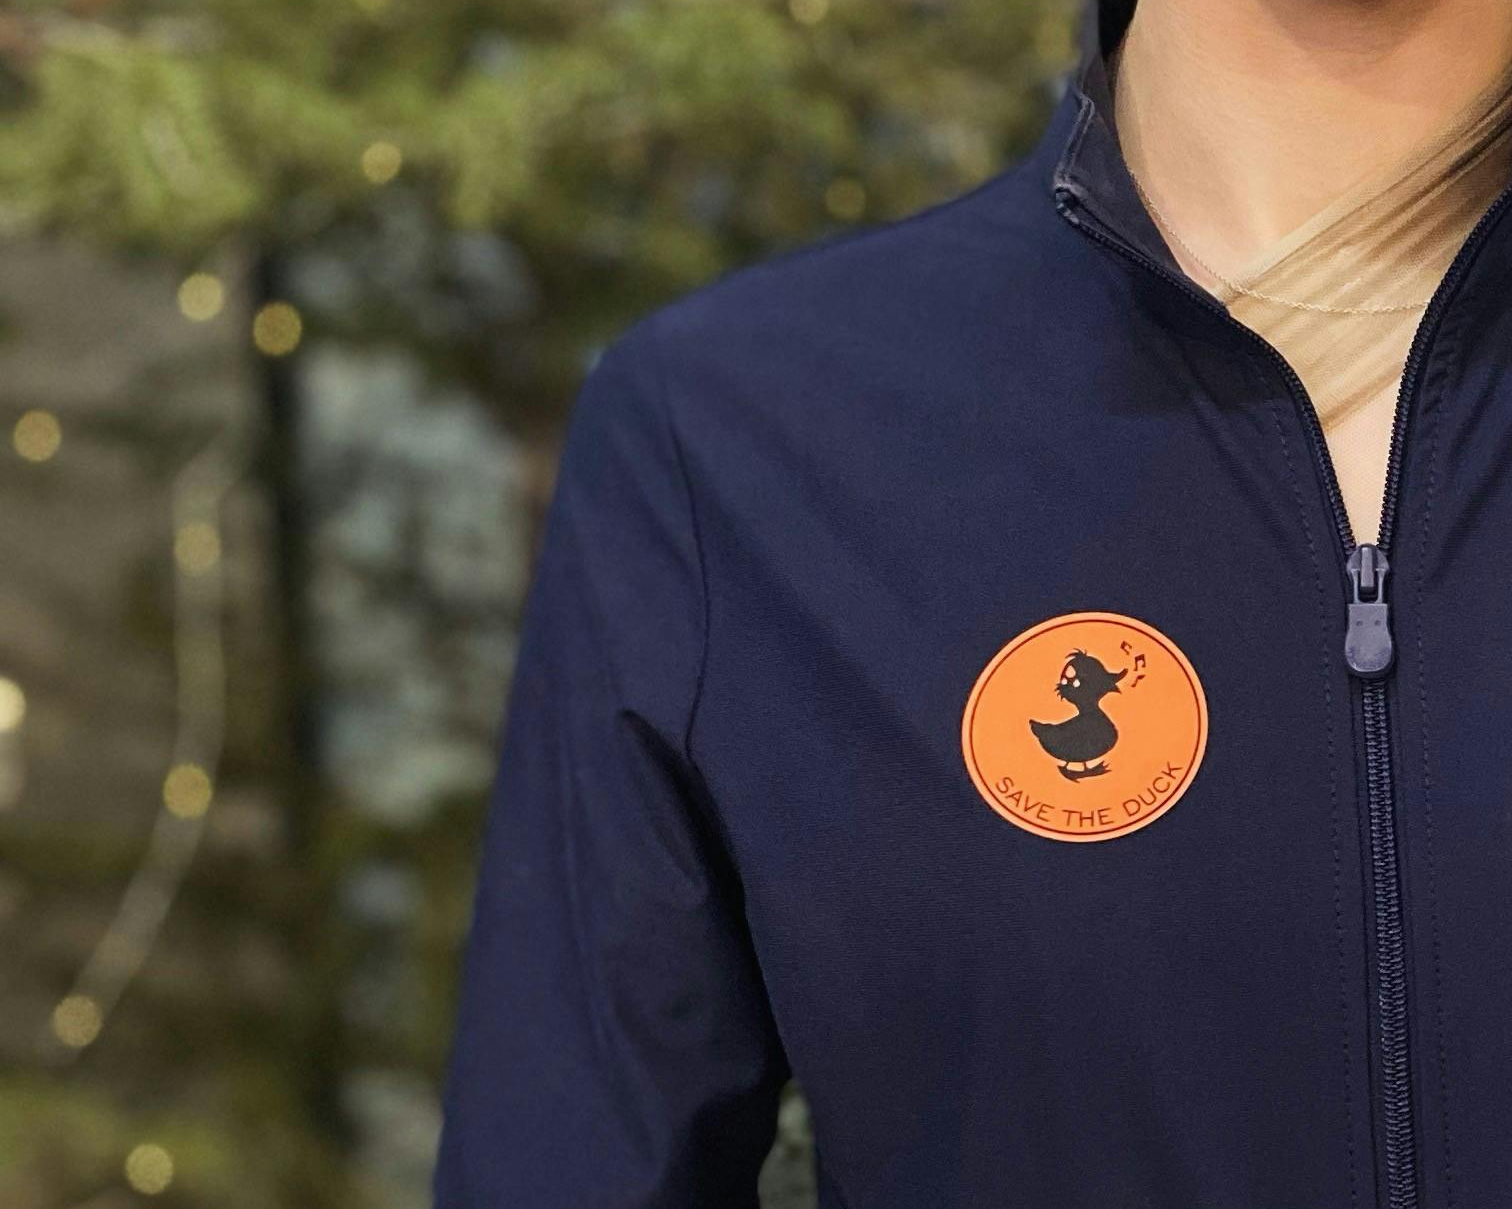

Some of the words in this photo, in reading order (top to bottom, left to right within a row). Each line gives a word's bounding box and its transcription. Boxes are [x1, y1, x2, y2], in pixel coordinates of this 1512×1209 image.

[995, 777, 1055, 822] SAVE
[1062, 807, 1114, 828] THE
[1122, 761, 1182, 818] DUCK
